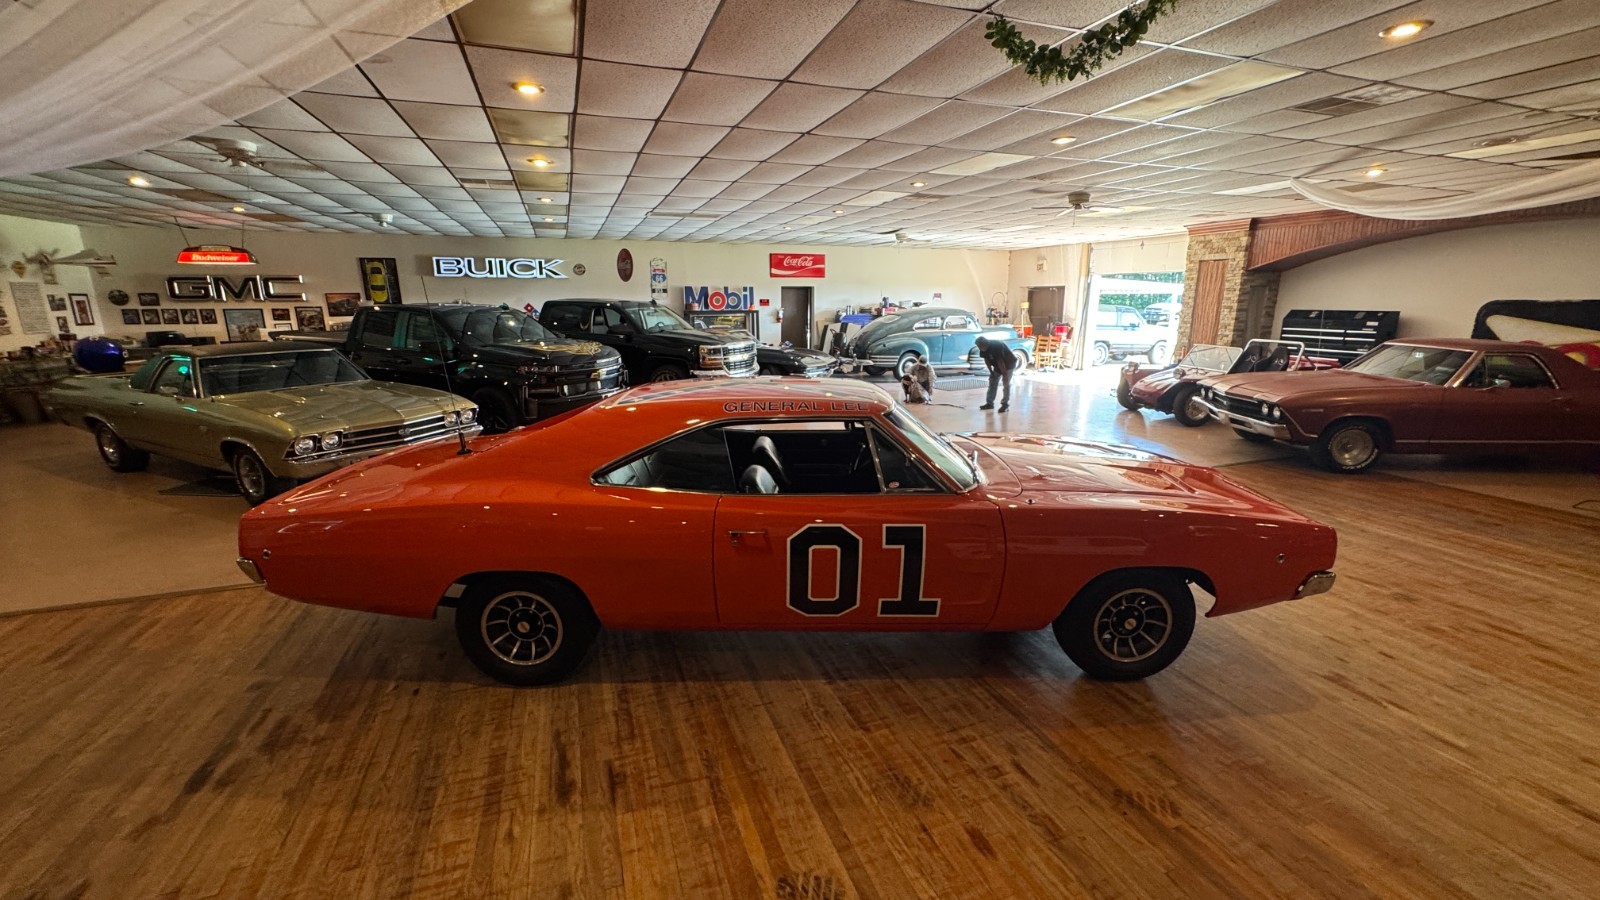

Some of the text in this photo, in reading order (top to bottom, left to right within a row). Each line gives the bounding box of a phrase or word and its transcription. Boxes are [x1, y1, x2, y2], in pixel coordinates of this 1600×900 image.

[191, 253, 240, 261] Budweiser
[431, 256, 568, 278] BUICK
[165, 275, 308, 302] GMC
[655, 274, 664, 282] 66
[684, 285, 755, 310] Mobil
[723, 401, 869, 413] GENERAL LEE
[786, 523, 942, 618] 01
